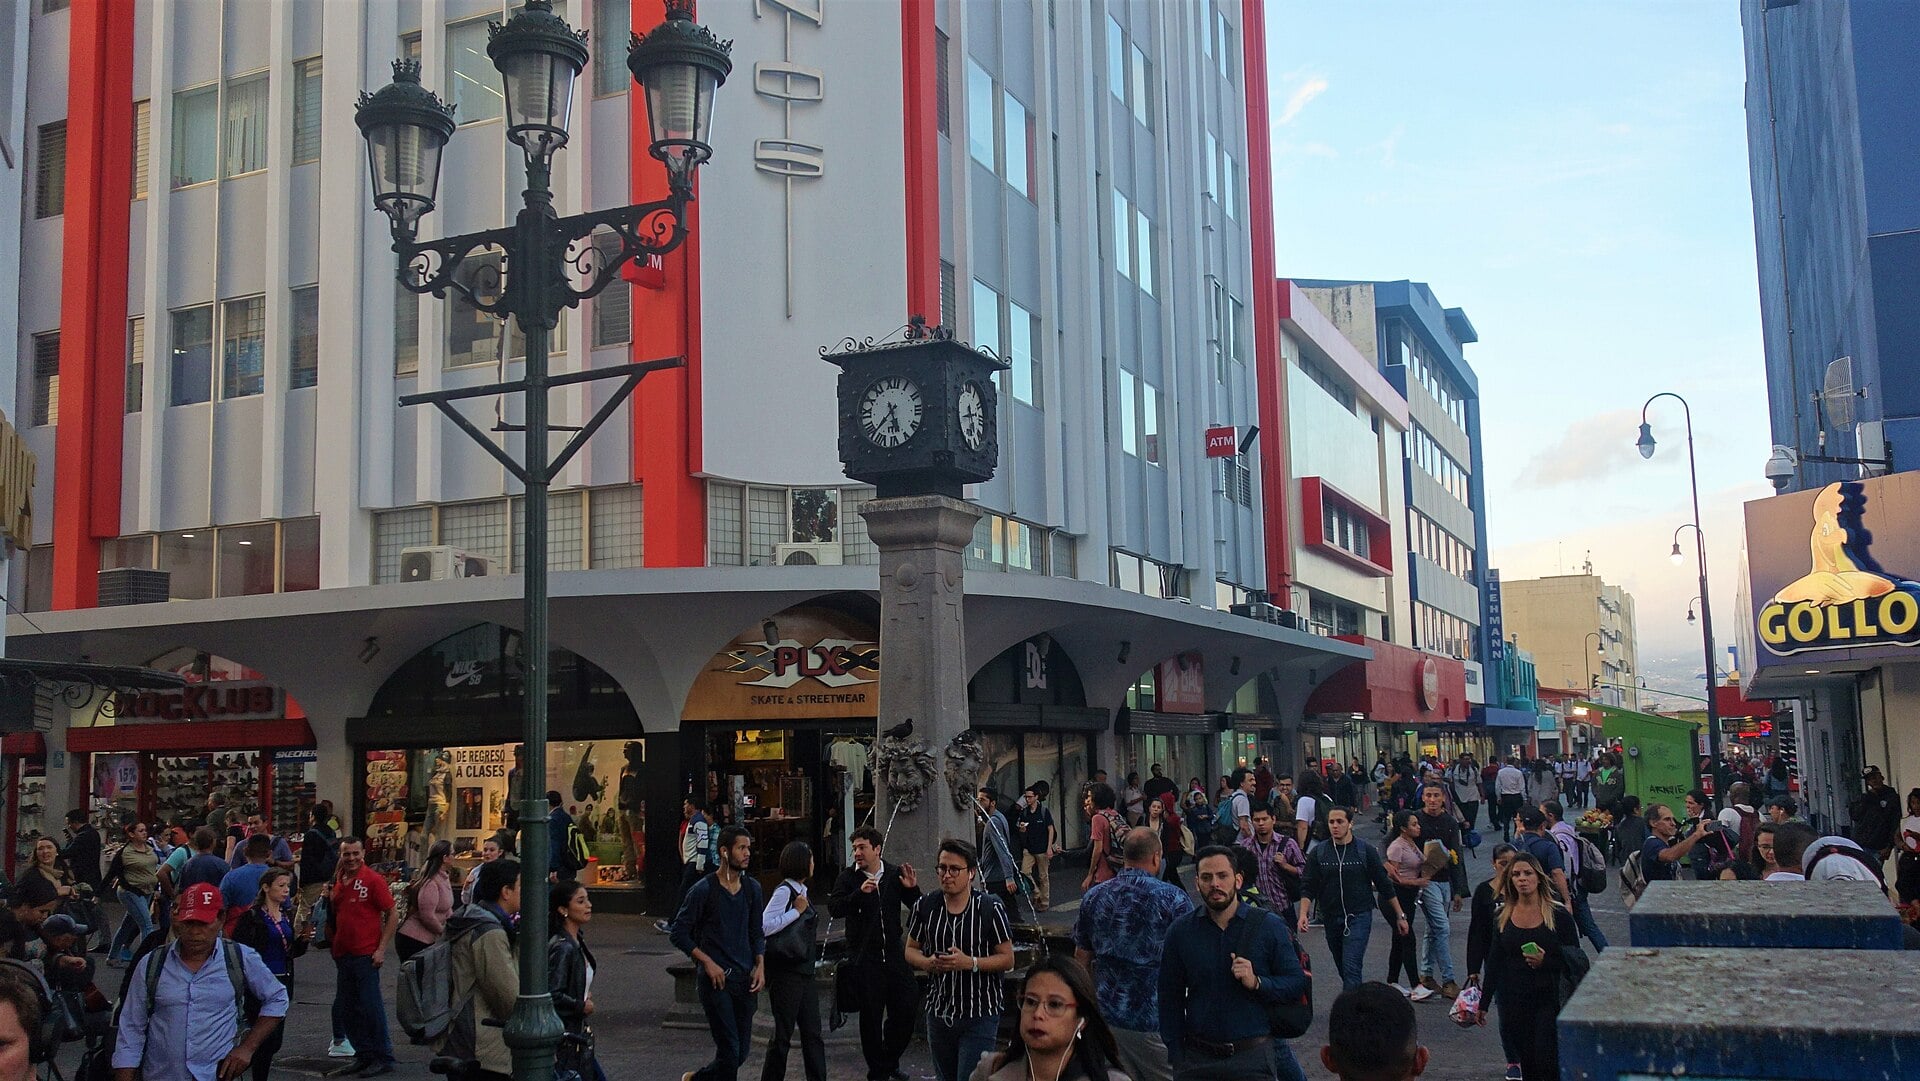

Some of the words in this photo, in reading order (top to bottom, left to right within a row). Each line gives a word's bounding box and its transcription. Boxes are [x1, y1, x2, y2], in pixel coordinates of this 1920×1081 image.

[1209, 435, 1234, 447] ATM
[1489, 582, 1502, 659] LEHMANN
[1759, 591, 1919, 644] GOLLO
[452, 660, 477, 674] NIKE
[750, 695, 784, 705] SKATE
[796, 694, 866, 704] STREETWEAR
[456, 750, 467, 763] DE
[468, 749, 505, 762] REGRESO
[118, 768, 137, 783] 15%
[456, 765, 463, 778] A
[466, 764, 505, 778] CLASES
[202, 891, 214, 905] F
